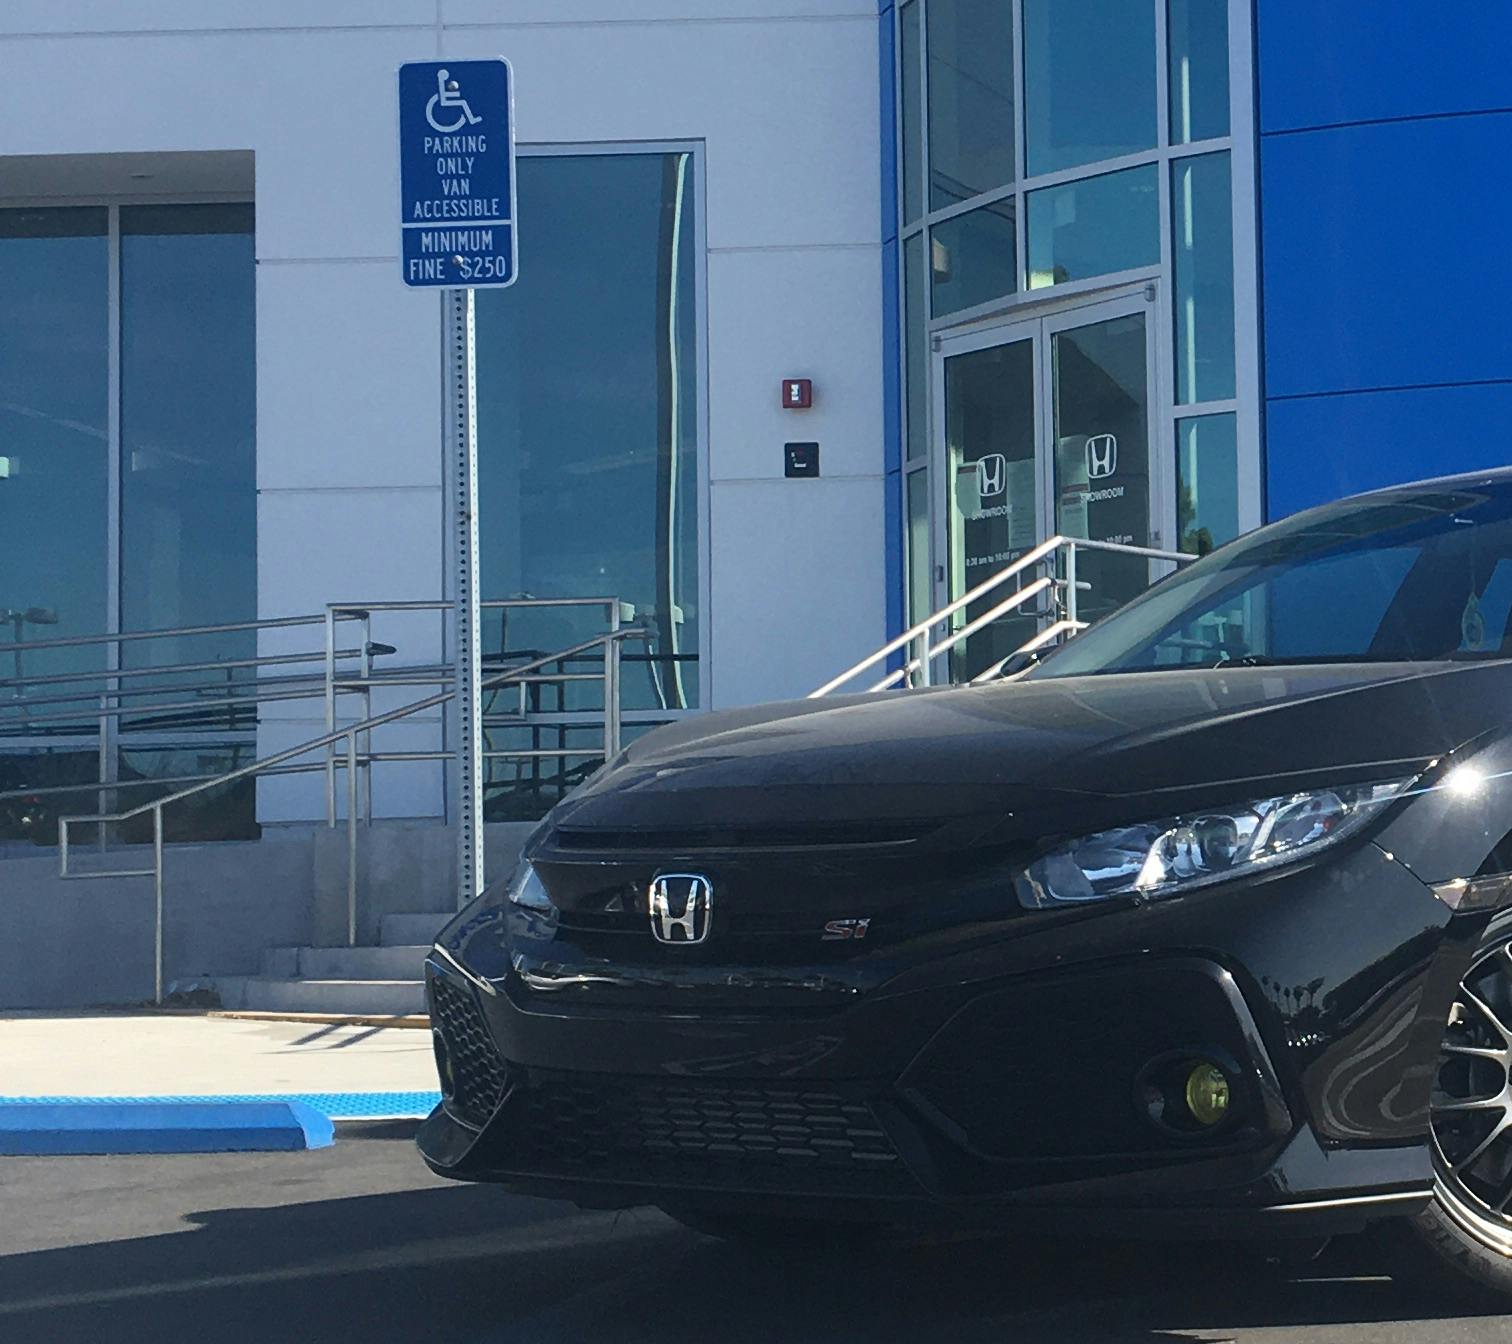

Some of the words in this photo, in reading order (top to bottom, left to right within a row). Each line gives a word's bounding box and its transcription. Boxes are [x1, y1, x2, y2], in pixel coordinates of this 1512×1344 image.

[424, 135, 487, 154] PARKING
[436, 157, 475, 175] ONLY
[441, 178, 470, 197] VAN
[413, 198, 500, 219] ACCESSIBLE
[421, 229, 494, 254] MINIMUM
[409, 257, 446, 281] FINE
[459, 255, 506, 280] $250
